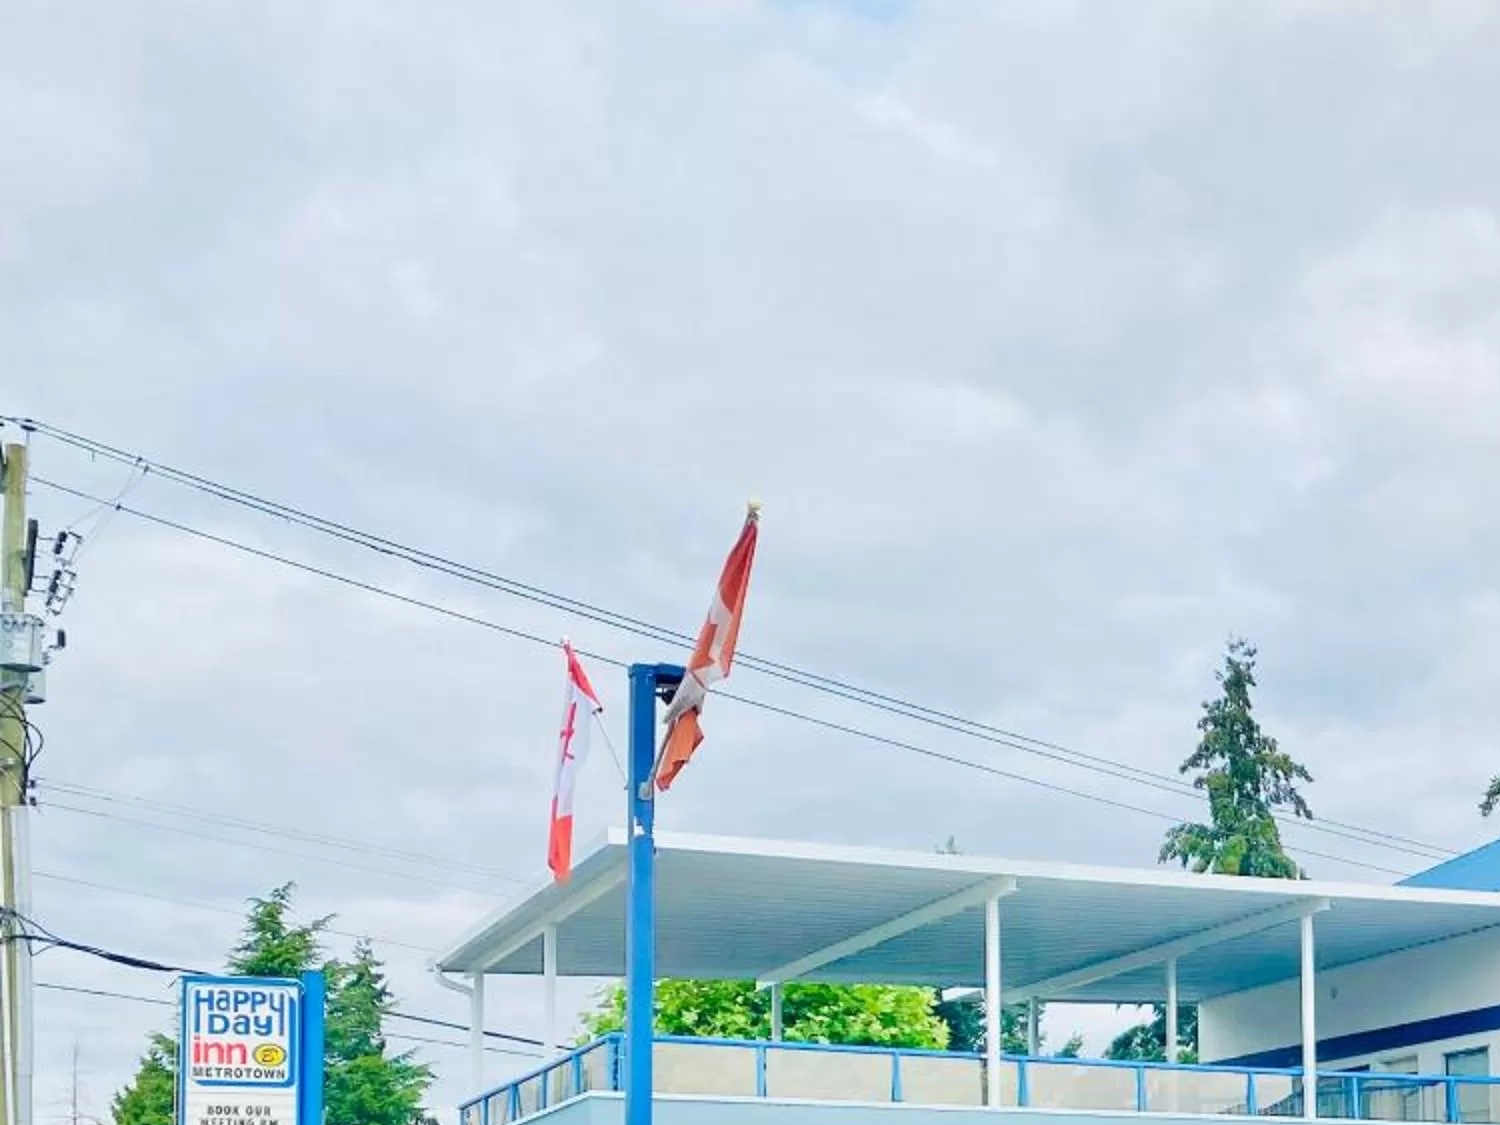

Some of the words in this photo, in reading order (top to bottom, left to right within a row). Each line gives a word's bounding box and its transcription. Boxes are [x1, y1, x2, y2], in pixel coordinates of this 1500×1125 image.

[193, 1035, 248, 1065] inn
[192, 1066, 285, 1079] METROTOWN
[207, 1104, 241, 1116] BOOK
[245, 1104, 271, 1117] OUR
